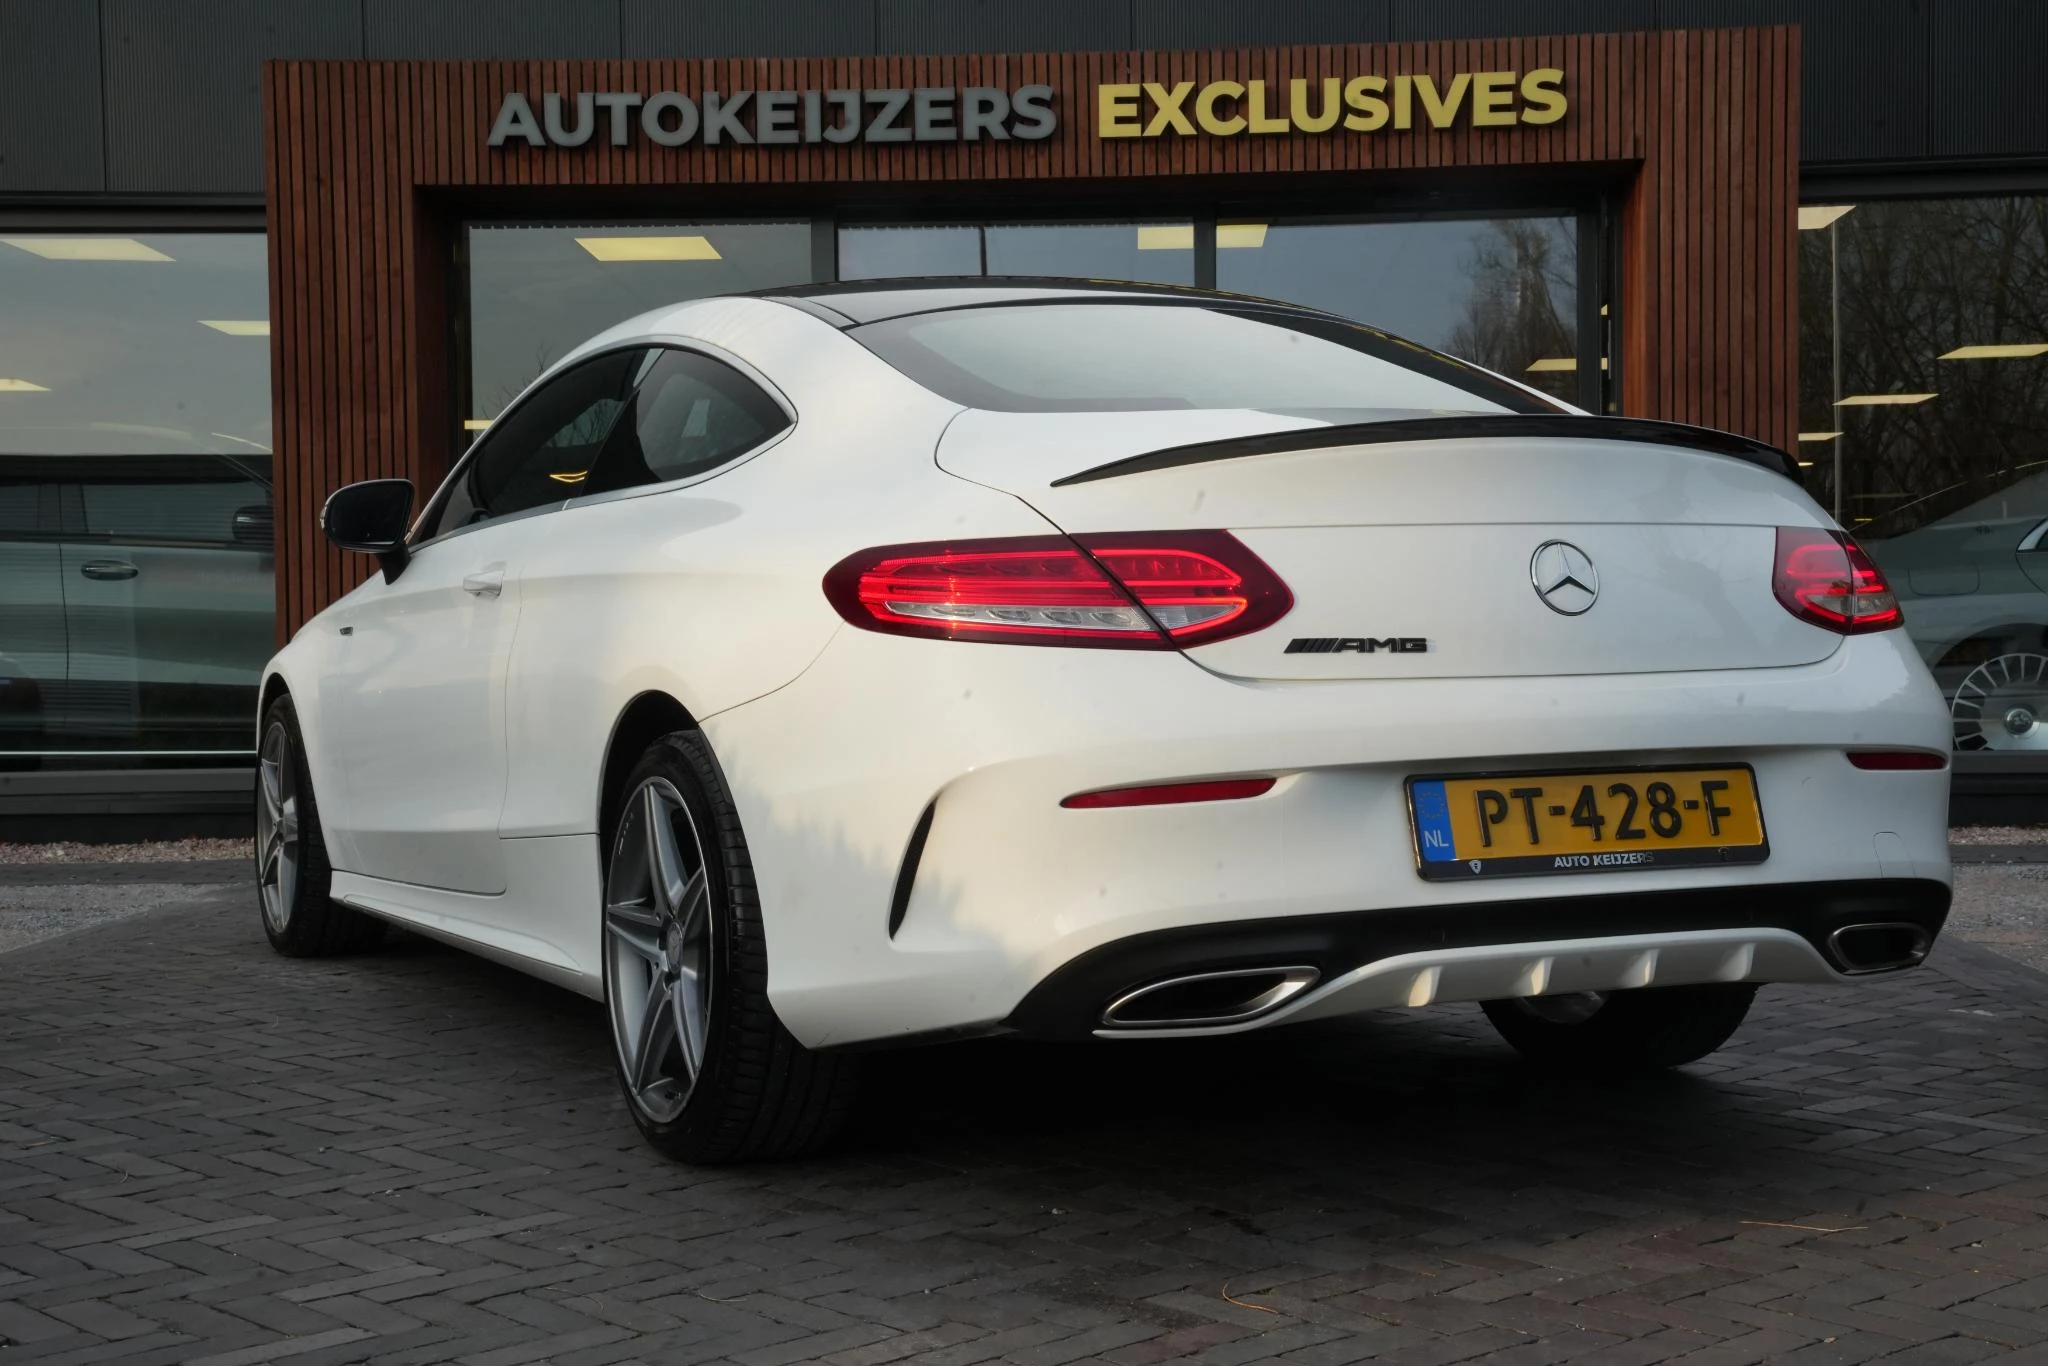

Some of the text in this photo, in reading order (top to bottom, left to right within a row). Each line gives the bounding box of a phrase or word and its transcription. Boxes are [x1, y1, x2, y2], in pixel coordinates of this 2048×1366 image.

[486, 68, 1568, 147] AUTOKEIJZERS EXCLUSIVES
[1330, 637, 1427, 653] AMG
[1474, 780, 1731, 848] PT-428-F
[1424, 830, 1449, 848] NL
[1554, 855, 1590, 868] AUTO
